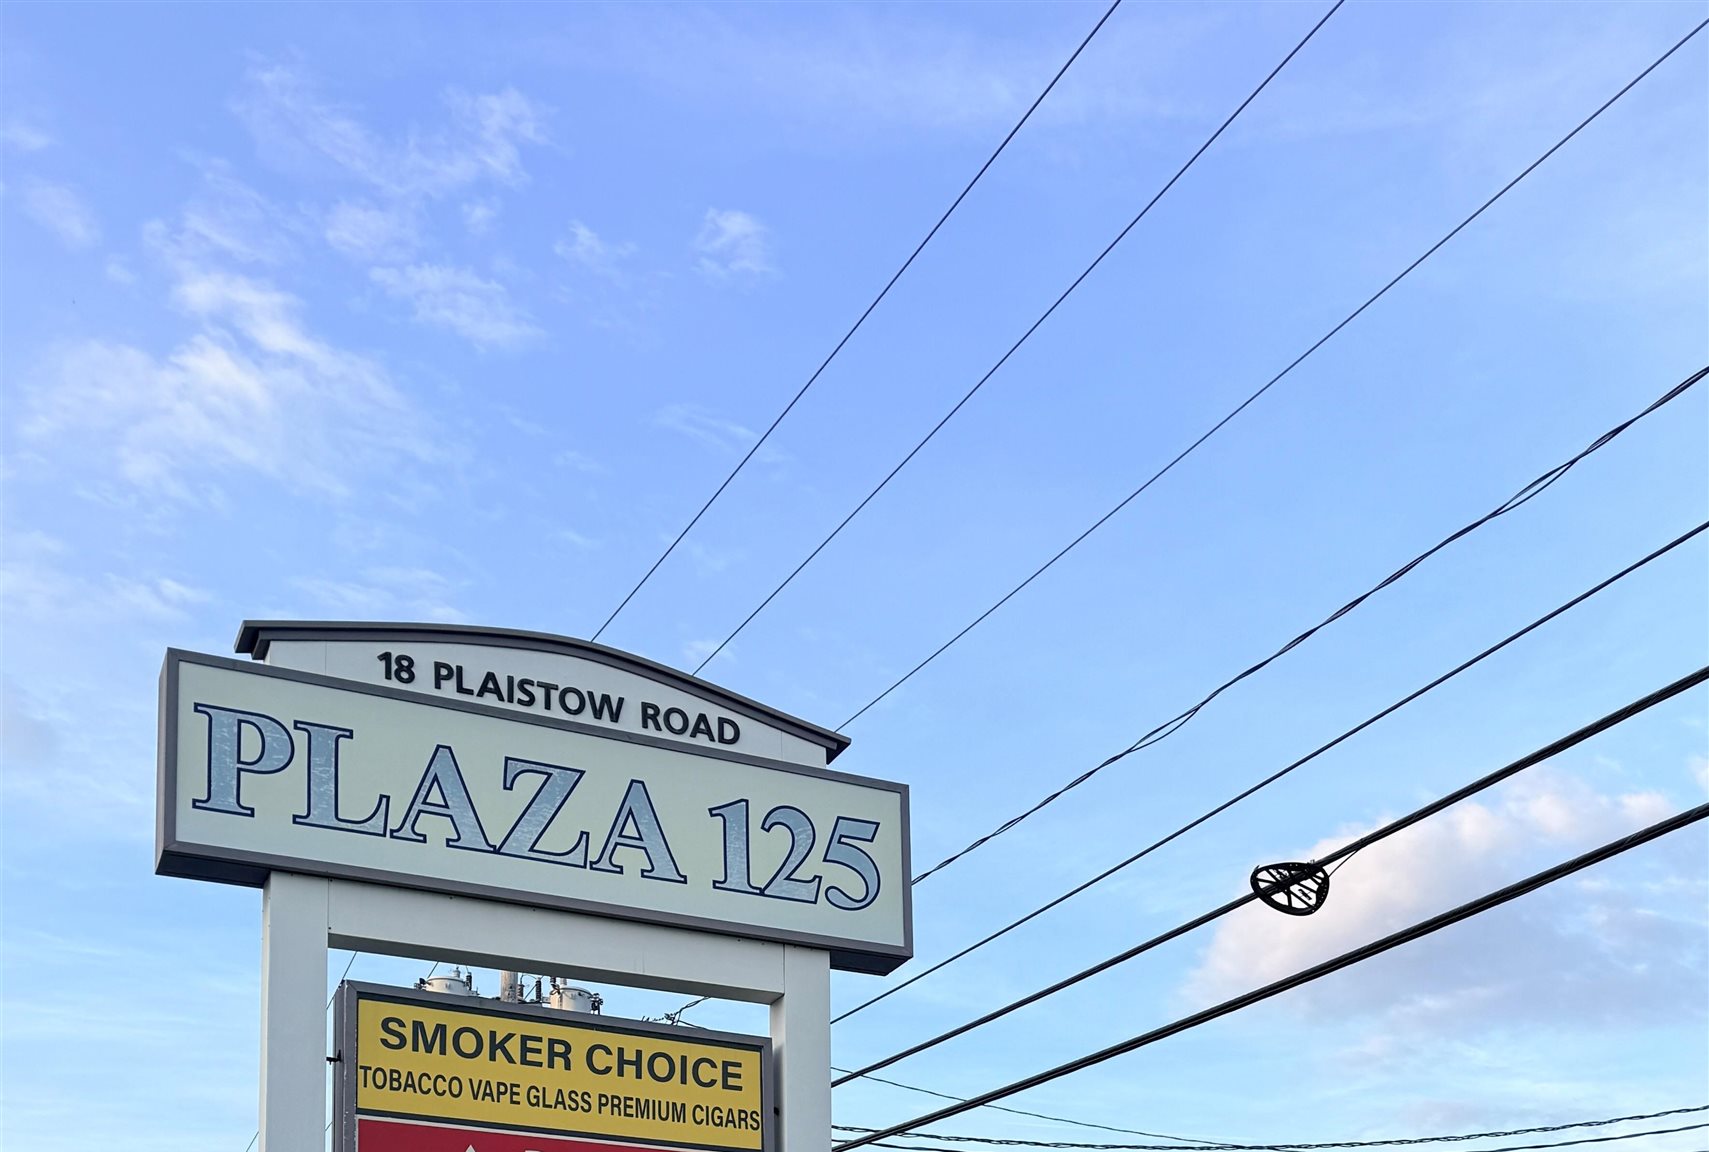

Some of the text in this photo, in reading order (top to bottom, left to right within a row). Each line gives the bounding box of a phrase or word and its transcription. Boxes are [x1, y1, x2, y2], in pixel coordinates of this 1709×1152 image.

[377, 652, 741, 745] 18 PLAISTOW ROAD
[192, 702, 881, 911] PLAZA 125
[379, 1016, 743, 1092] SMOKER CHOICE
[359, 1065, 760, 1131] TOBACCO VAPE GLASS PREMIUM CIGARS
